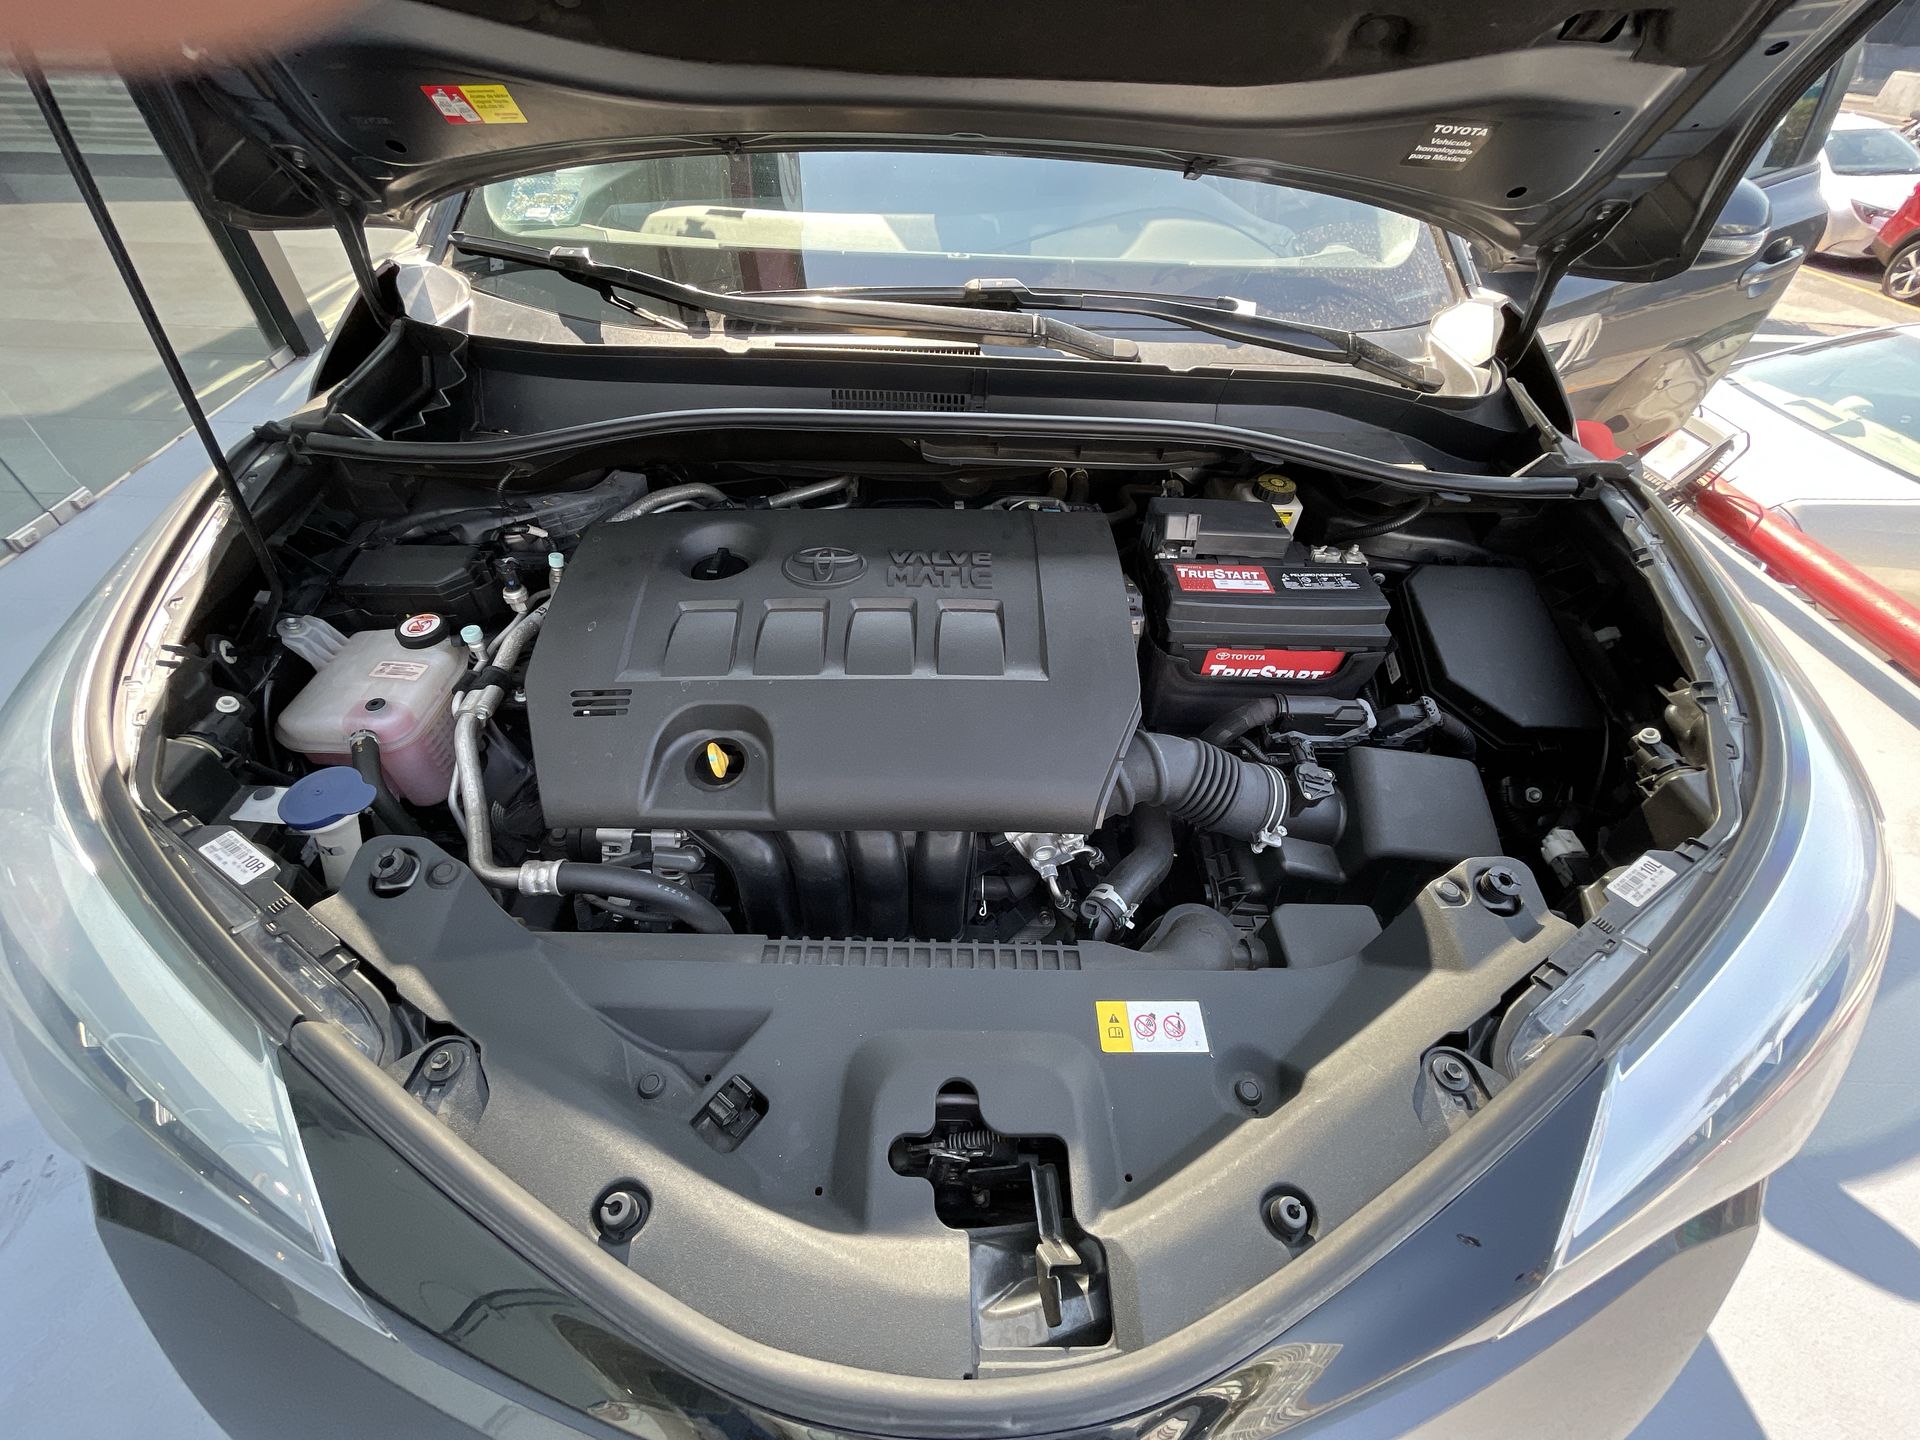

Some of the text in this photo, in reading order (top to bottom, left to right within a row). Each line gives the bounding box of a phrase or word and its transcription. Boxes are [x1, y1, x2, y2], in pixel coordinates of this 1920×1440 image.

[1434, 124, 1488, 136] TOYOTA
[1415, 145, 1473, 155] homologado
[888, 551, 992, 565] VALVE
[887, 565, 992, 588] MATIC
[1231, 653, 1266, 661] TOYOTA
[242, 855, 266, 873] 10R
[1641, 861, 1662, 875] 10L
